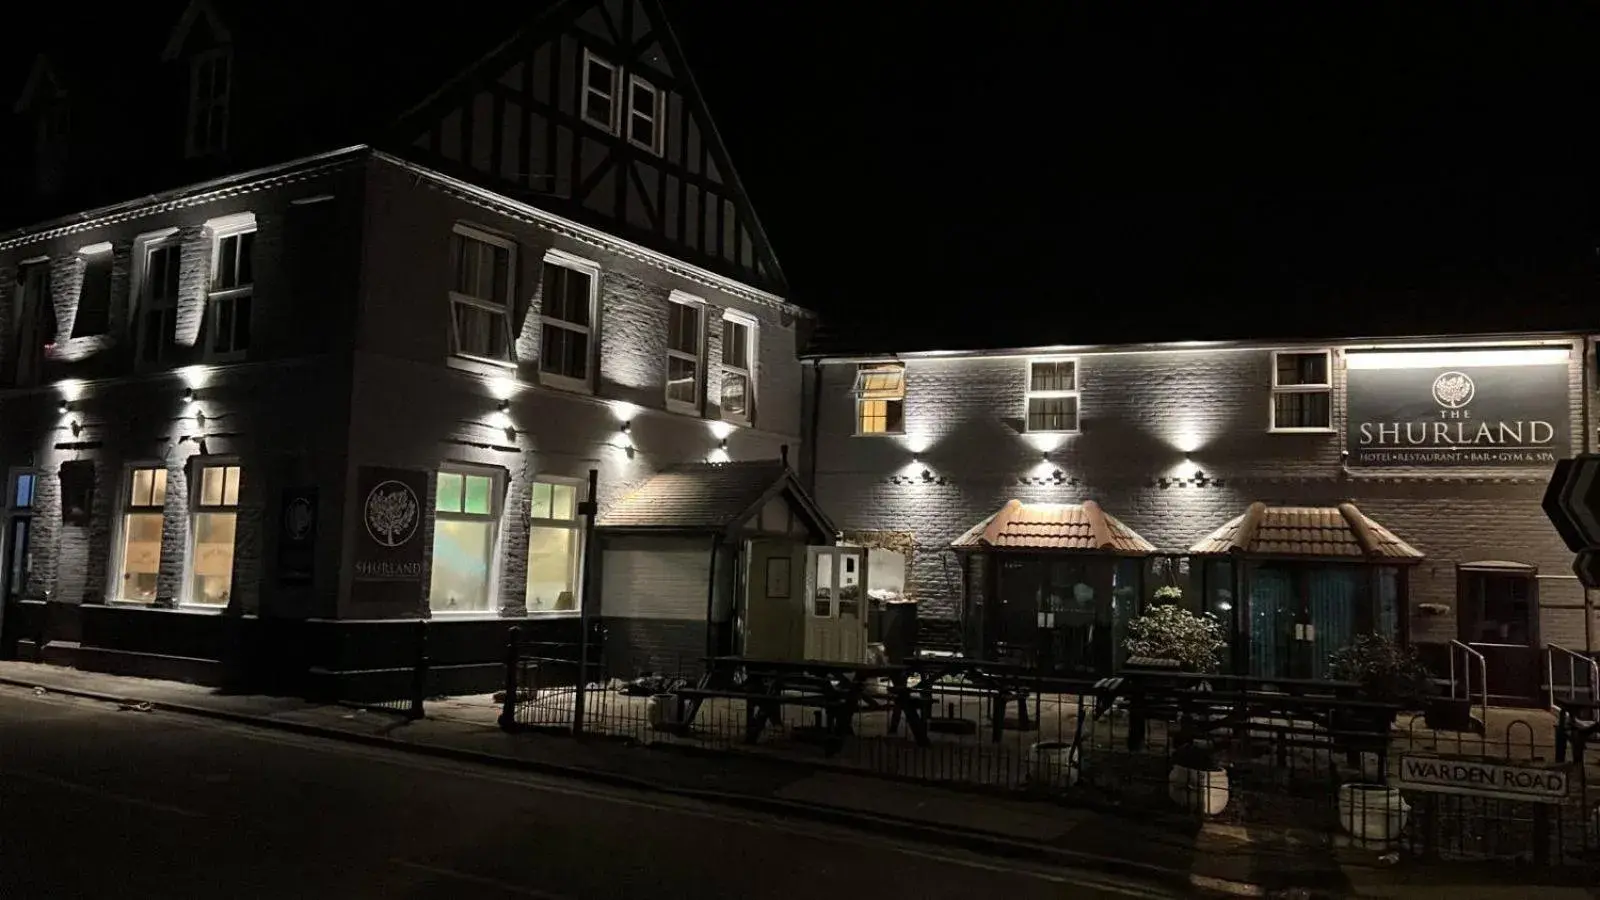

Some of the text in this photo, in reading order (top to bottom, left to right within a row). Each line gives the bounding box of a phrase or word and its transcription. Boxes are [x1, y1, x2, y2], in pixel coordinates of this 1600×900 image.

[1439, 410, 1471, 419] THE
[1360, 420, 1555, 444] SHURLAND
[1360, 453, 1390, 461] HOTEL
[1398, 453, 1461, 461] RESTAURANT
[1470, 453, 1490, 461] BAR
[1499, 452, 1523, 461] GYM
[1536, 452, 1554, 461] SPA
[1406, 761, 1563, 791] WARDEN ROAD
